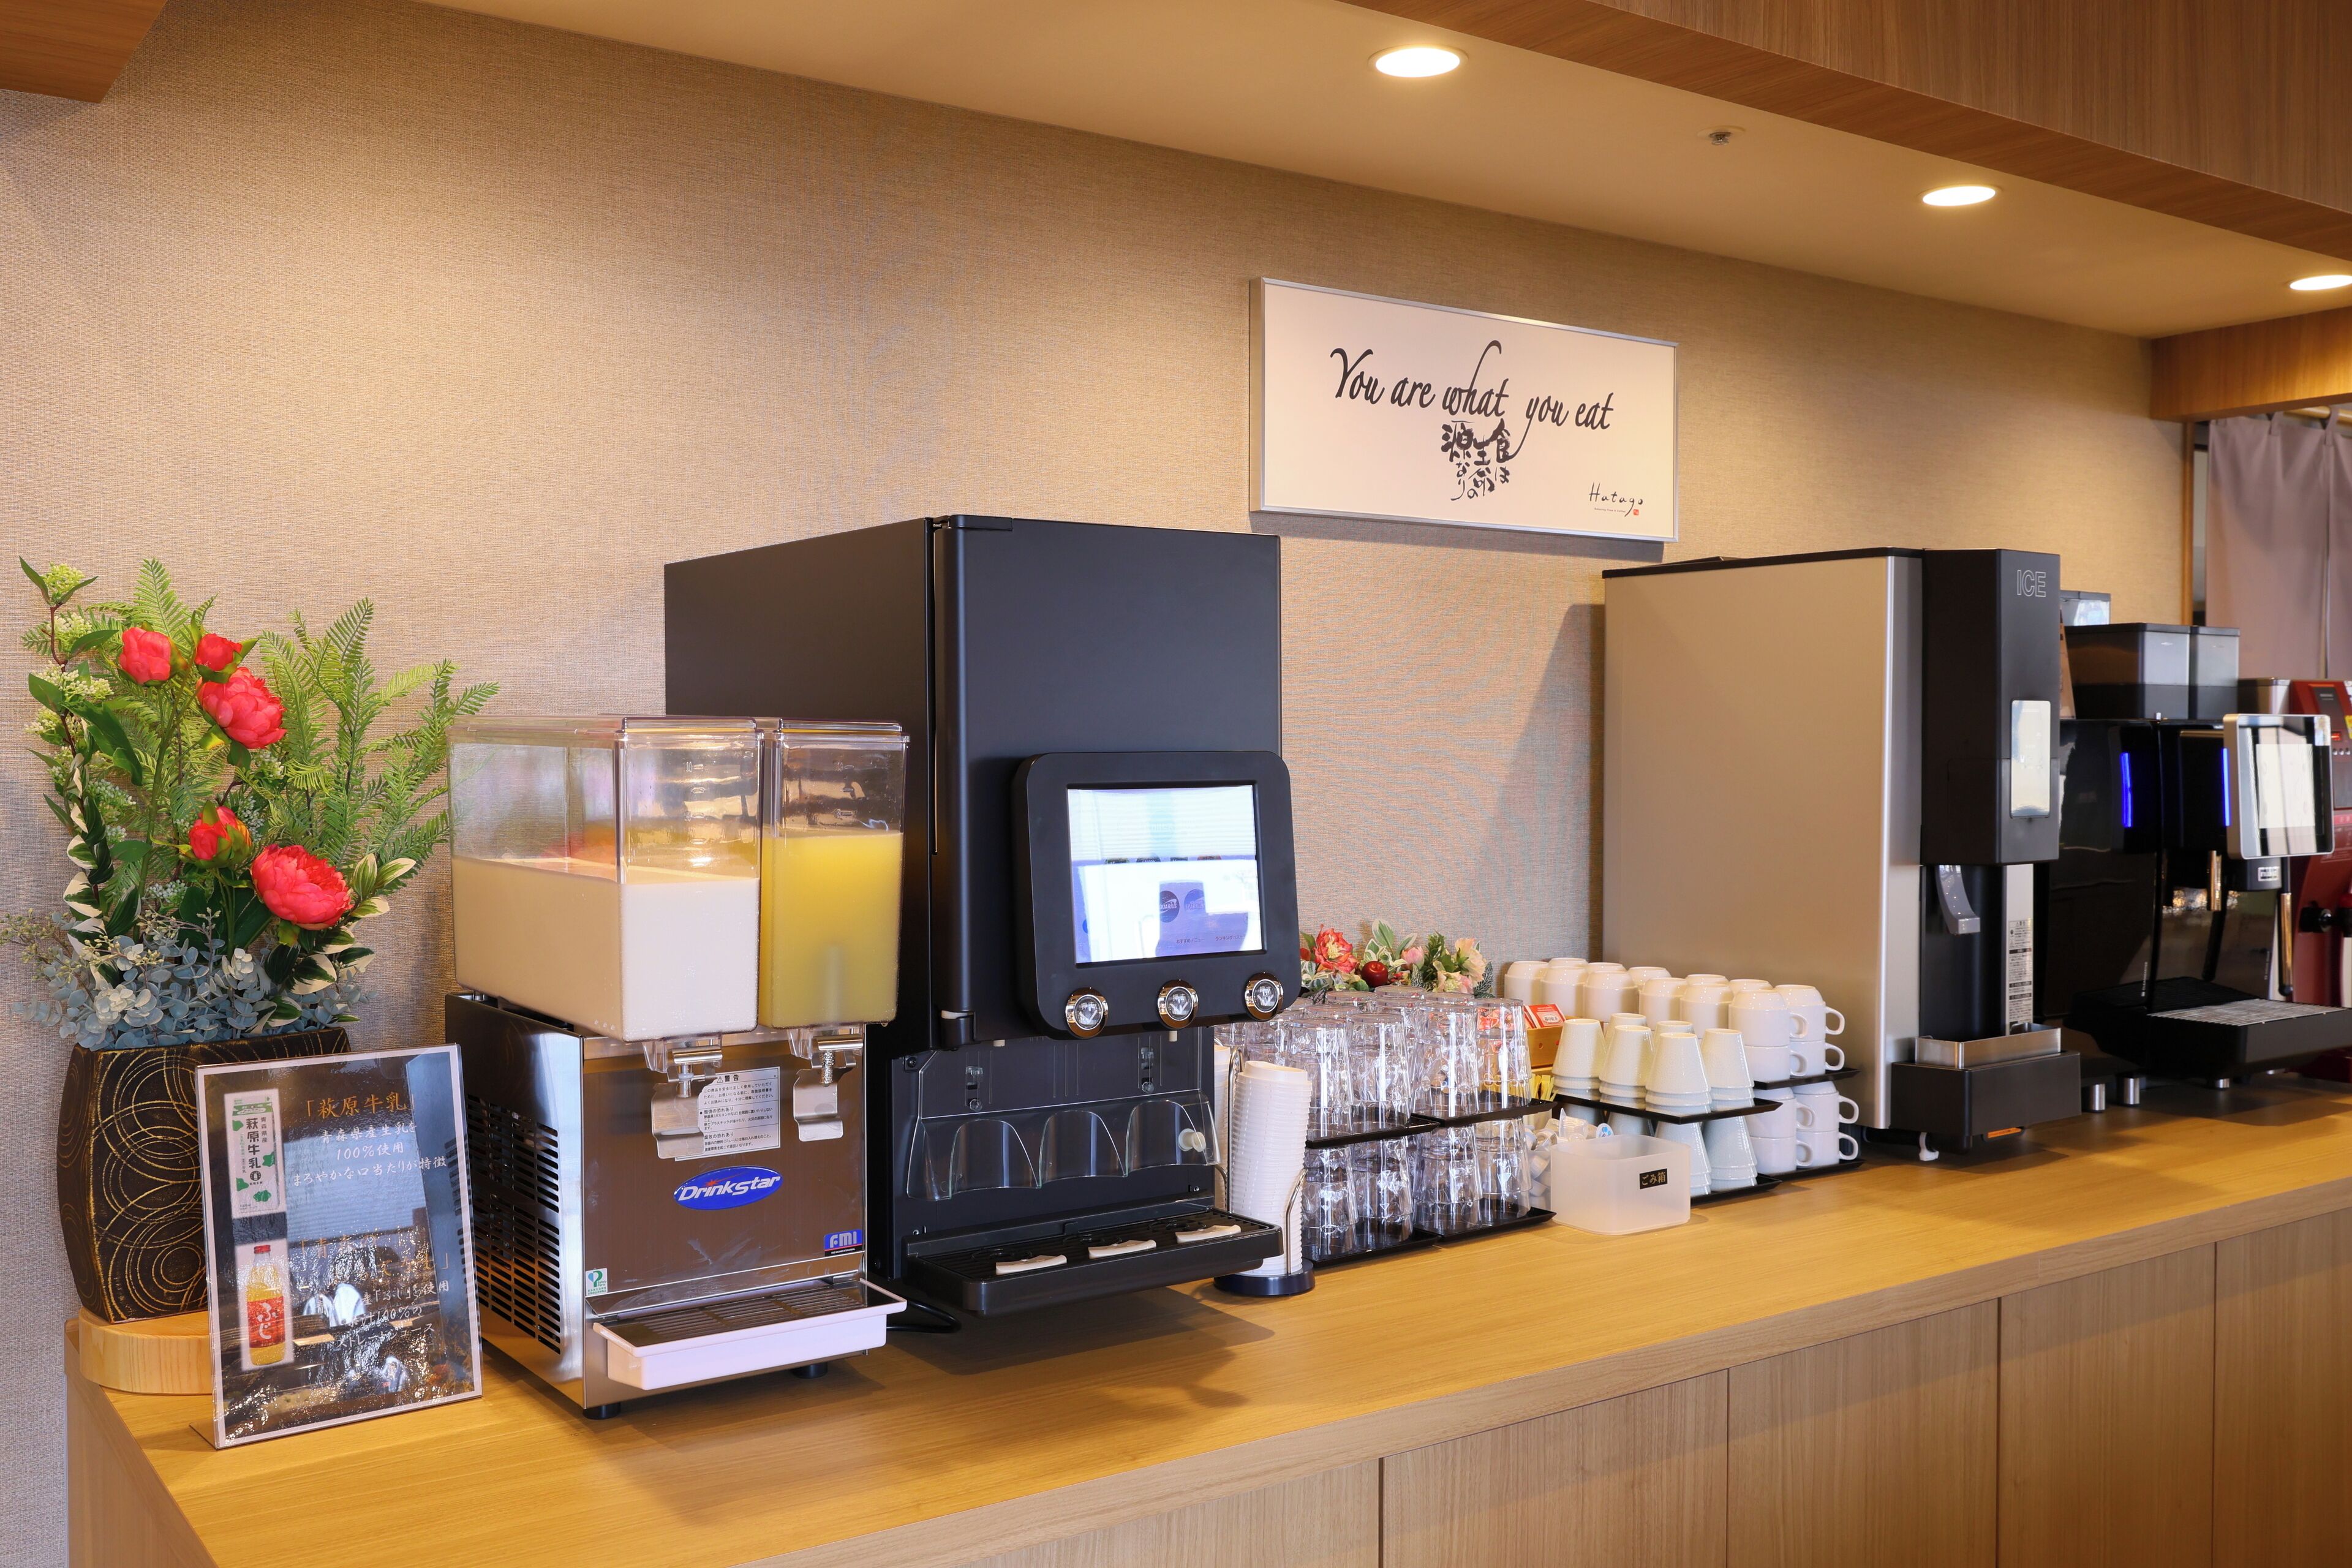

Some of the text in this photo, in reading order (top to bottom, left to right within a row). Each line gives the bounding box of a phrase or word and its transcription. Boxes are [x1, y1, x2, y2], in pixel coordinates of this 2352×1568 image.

[1330, 347, 1385, 404] You
[1390, 377, 1436, 409] are
[1442, 340, 1509, 417] what
[1575, 392, 1614, 430] eat
[1588, 481, 1643, 517] Hatago
[2016, 569, 2046, 597] ICE
[246, 1117, 262, 1169] 萩原牛乳
[320, 1120, 417, 1144] 青森県産生乳を
[337, 1142, 404, 1161] 100%使用
[293, 1156, 447, 1187] まろやかな口当たりが特徴
[1642, 1172, 1666, 1186] ごみ箱
[257, 1302, 277, 1340] ふじ
